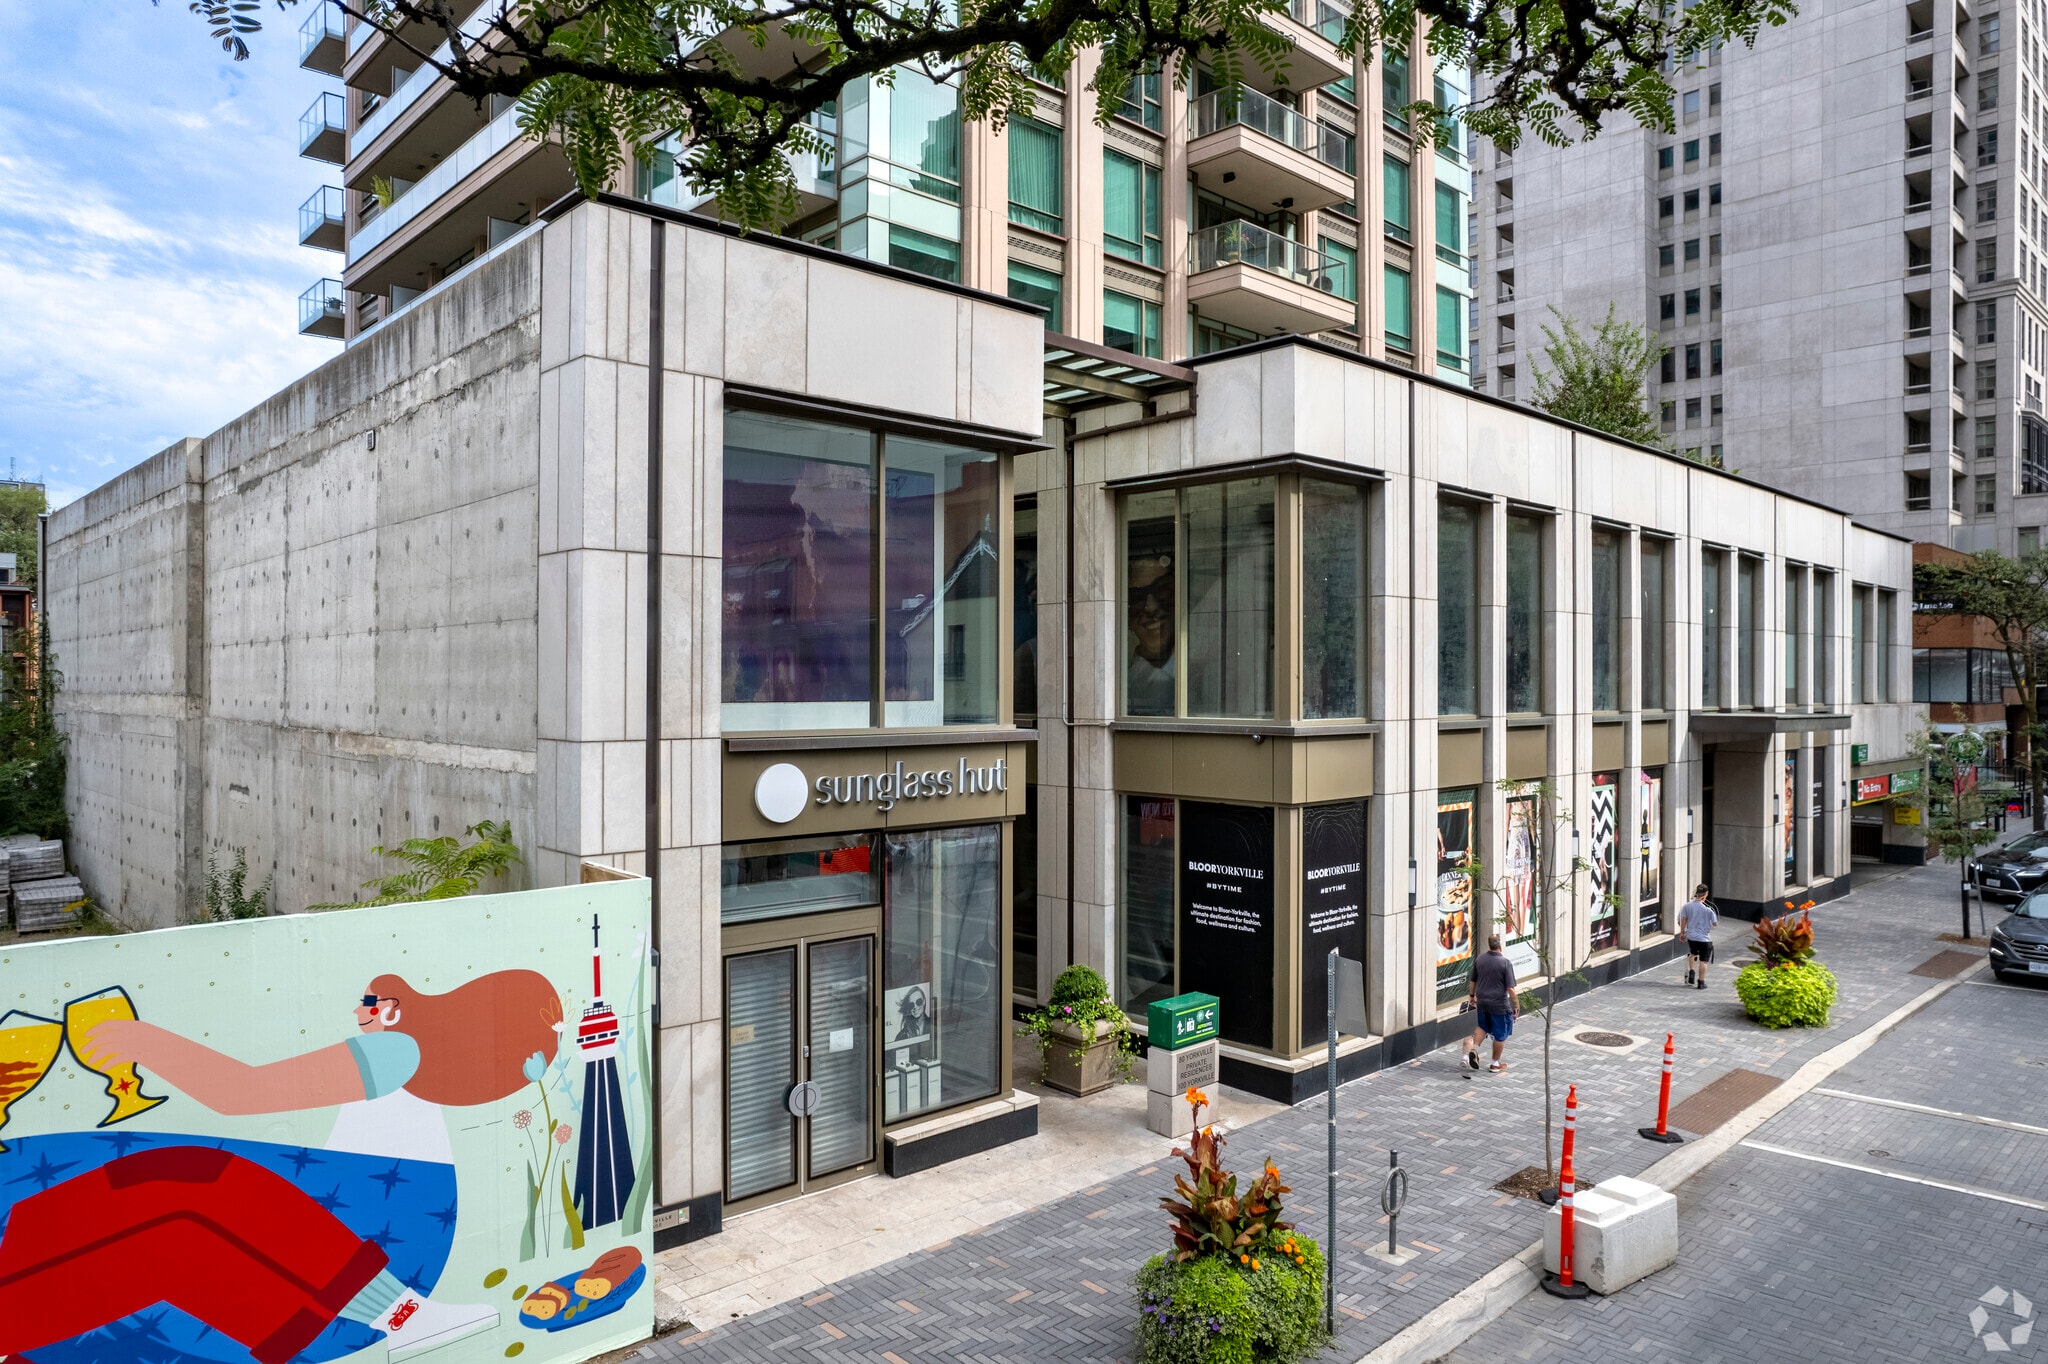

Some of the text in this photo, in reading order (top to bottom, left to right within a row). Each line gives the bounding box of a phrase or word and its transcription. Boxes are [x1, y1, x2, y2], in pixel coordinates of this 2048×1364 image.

[815, 756, 1007, 811] sunglass hut
[1188, 860, 1264, 880] BLOORYORKVILLE
[1307, 862, 1360, 881] BLOORYORKVILLE
[1186, 1046, 1213, 1060] YORKVILLE
[1180, 1063, 1212, 1079] RESIDENCES
[1186, 1058, 1207, 1070] PRIVATE
[1178, 1072, 1214, 1090] 100 YORKVILLE
